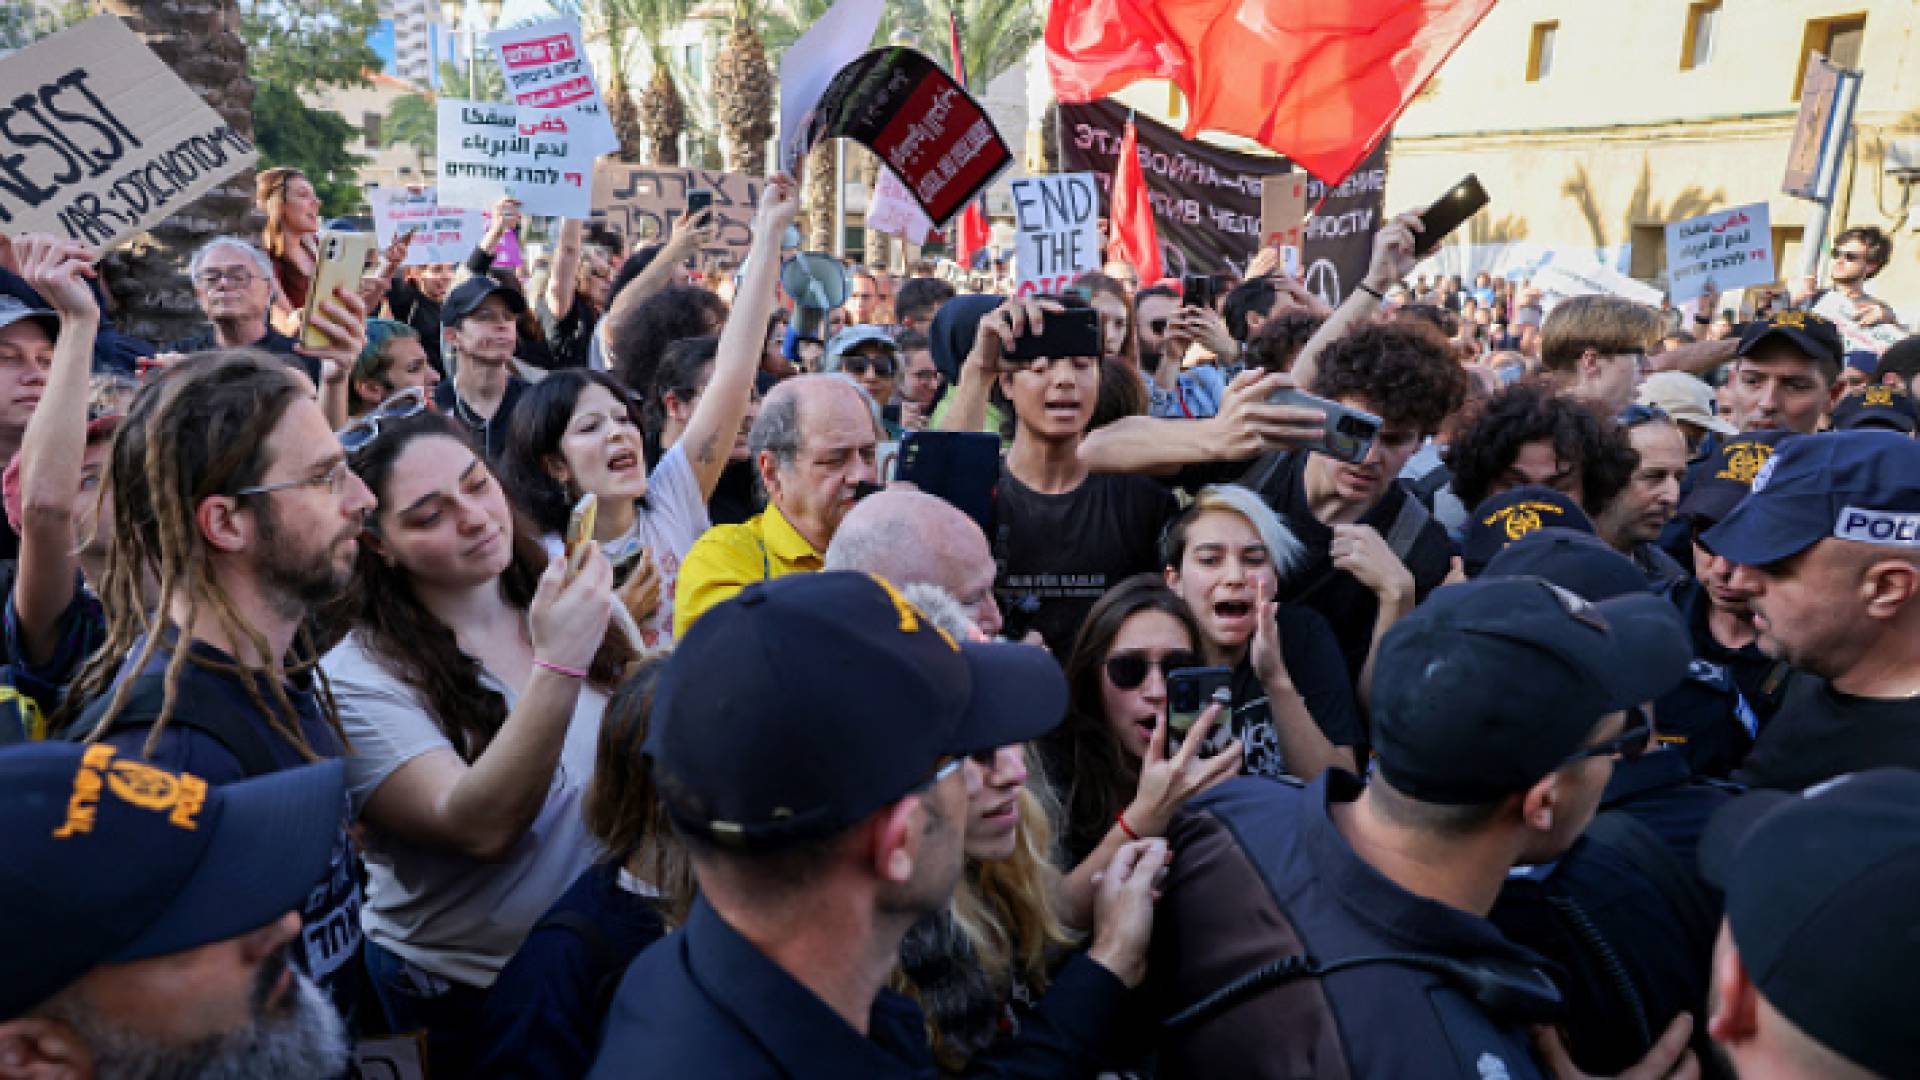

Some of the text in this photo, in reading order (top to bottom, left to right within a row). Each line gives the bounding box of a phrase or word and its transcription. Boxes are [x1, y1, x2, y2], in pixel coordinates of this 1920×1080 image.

[0, 67, 143, 222] ESIST
[513, 166, 560, 185] להרג
[1011, 177, 1092, 232] END
[1030, 228, 1084, 275] THE
